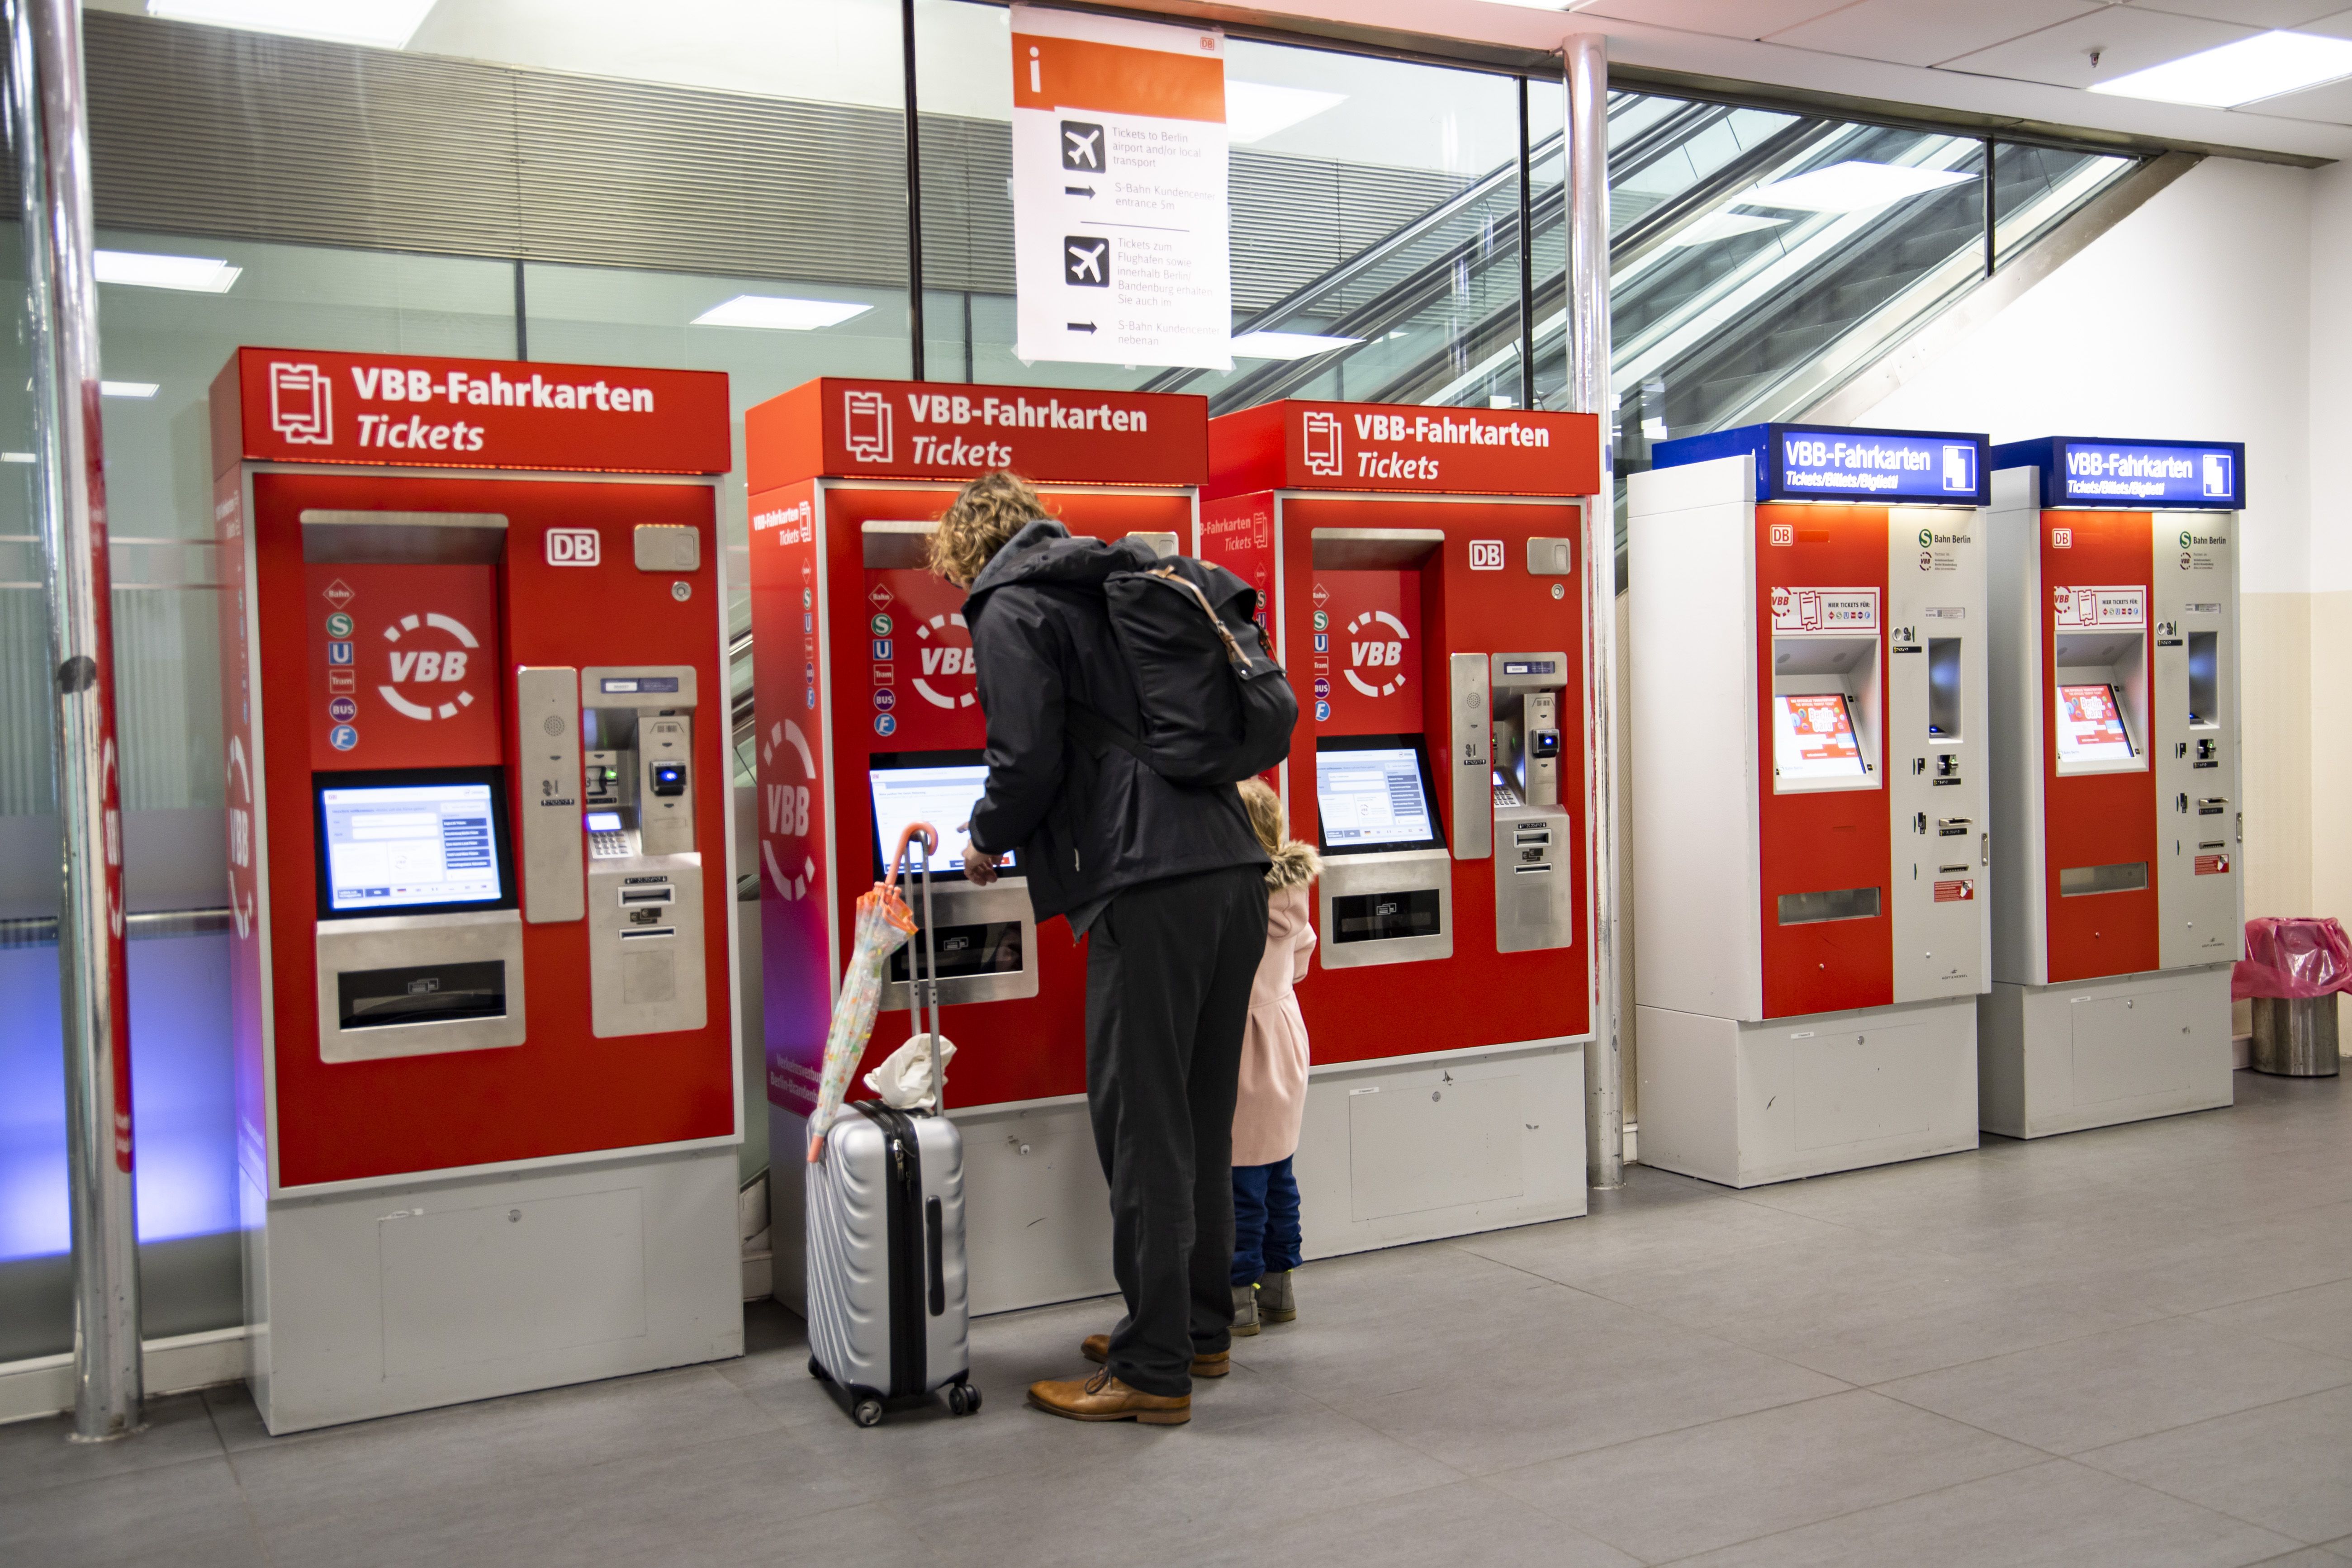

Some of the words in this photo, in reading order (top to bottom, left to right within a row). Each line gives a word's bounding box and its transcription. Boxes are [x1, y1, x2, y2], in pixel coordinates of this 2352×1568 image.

[1201, 39, 1214, 48] DB
[1029, 47, 1041, 92] i
[1112, 127, 1146, 140] Tickets
[1149, 132, 1157, 141] to
[1162, 132, 1188, 142] Berlin
[1113, 143, 1143, 156] airport
[1146, 145, 1176, 156] and/or
[1180, 148, 1201, 158] local
[1113, 156, 1156, 168] transport
[1115, 182, 1151, 194] S-Bahn
[1154, 185, 1216, 201] Kundencenter
[1116, 198, 1157, 209] entrance
[1161, 199, 1175, 210] 5m
[1118, 238, 1150, 250] Tickets
[1153, 243, 1172, 251] zum
[1118, 252, 1163, 265] Flughafen
[1166, 258, 1192, 268] sowie
[1118, 267, 1160, 279] innerhalb
[1163, 270, 1191, 281] Berlin/
[1118, 280, 1174, 296] Bandenburg
[1176, 287, 1213, 296] erhalten
[1118, 294, 1133, 305] Sie
[1136, 296, 1158, 306] auch
[1161, 298, 1171, 307] im
[1118, 320, 1152, 332] S-Bahn
[1156, 322, 1220, 335] Kundencenter
[1118, 335, 1159, 346] nebenan
[351, 366, 653, 412] VBB-Fahrkarten
[907, 393, 1148, 432] VBB-Fahrkarten
[356, 414, 484, 451] Tickets
[1354, 414, 1550, 447] VBB-Fahrkarten
[911, 436, 1012, 467] Tickets
[1785, 441, 1931, 471] VBB-Fahrkarten
[1357, 451, 1439, 480] Tickets
[2067, 452, 2192, 478] VBB-Fahrkarten
[754, 507, 799, 531] VBB-Fahrkarten
[1200, 517, 1251, 536] B-Fahrkarten
[780, 529, 799, 546] Tickets
[1225, 536, 1252, 551] Tickets
[1773, 529, 1790, 542] DB
[1935, 535, 1950, 543] Bahn
[1952, 535, 1971, 543] Berlin
[2055, 532, 2068, 544] DB
[553, 535, 593, 561] DB
[1473, 545, 1500, 566] DB
[803, 590, 810, 607] S
[1257, 591, 1265, 607] S
[1772, 596, 1789, 606] VBB
[2054, 595, 2069, 603] VBB
[332, 616, 349, 634] S
[805, 615, 811, 632] U
[875, 616, 889, 634] S
[1314, 613, 1326, 629] S
[876, 641, 889, 658] U
[1314, 635, 1326, 651] U
[332, 644, 349, 663] U
[1351, 642, 1402, 667] VBB
[389, 651, 468, 682] VBB
[1314, 684, 1328, 692] BUS
[876, 696, 893, 704] BUS
[2082, 698, 2101, 707] Berlin
[332, 705, 354, 715] BUS
[1315, 703, 1326, 718] F
[1810, 710, 1832, 720] Berlin
[878, 716, 890, 732] F
[336, 729, 350, 746] F
[767, 784, 810, 837] VBB
